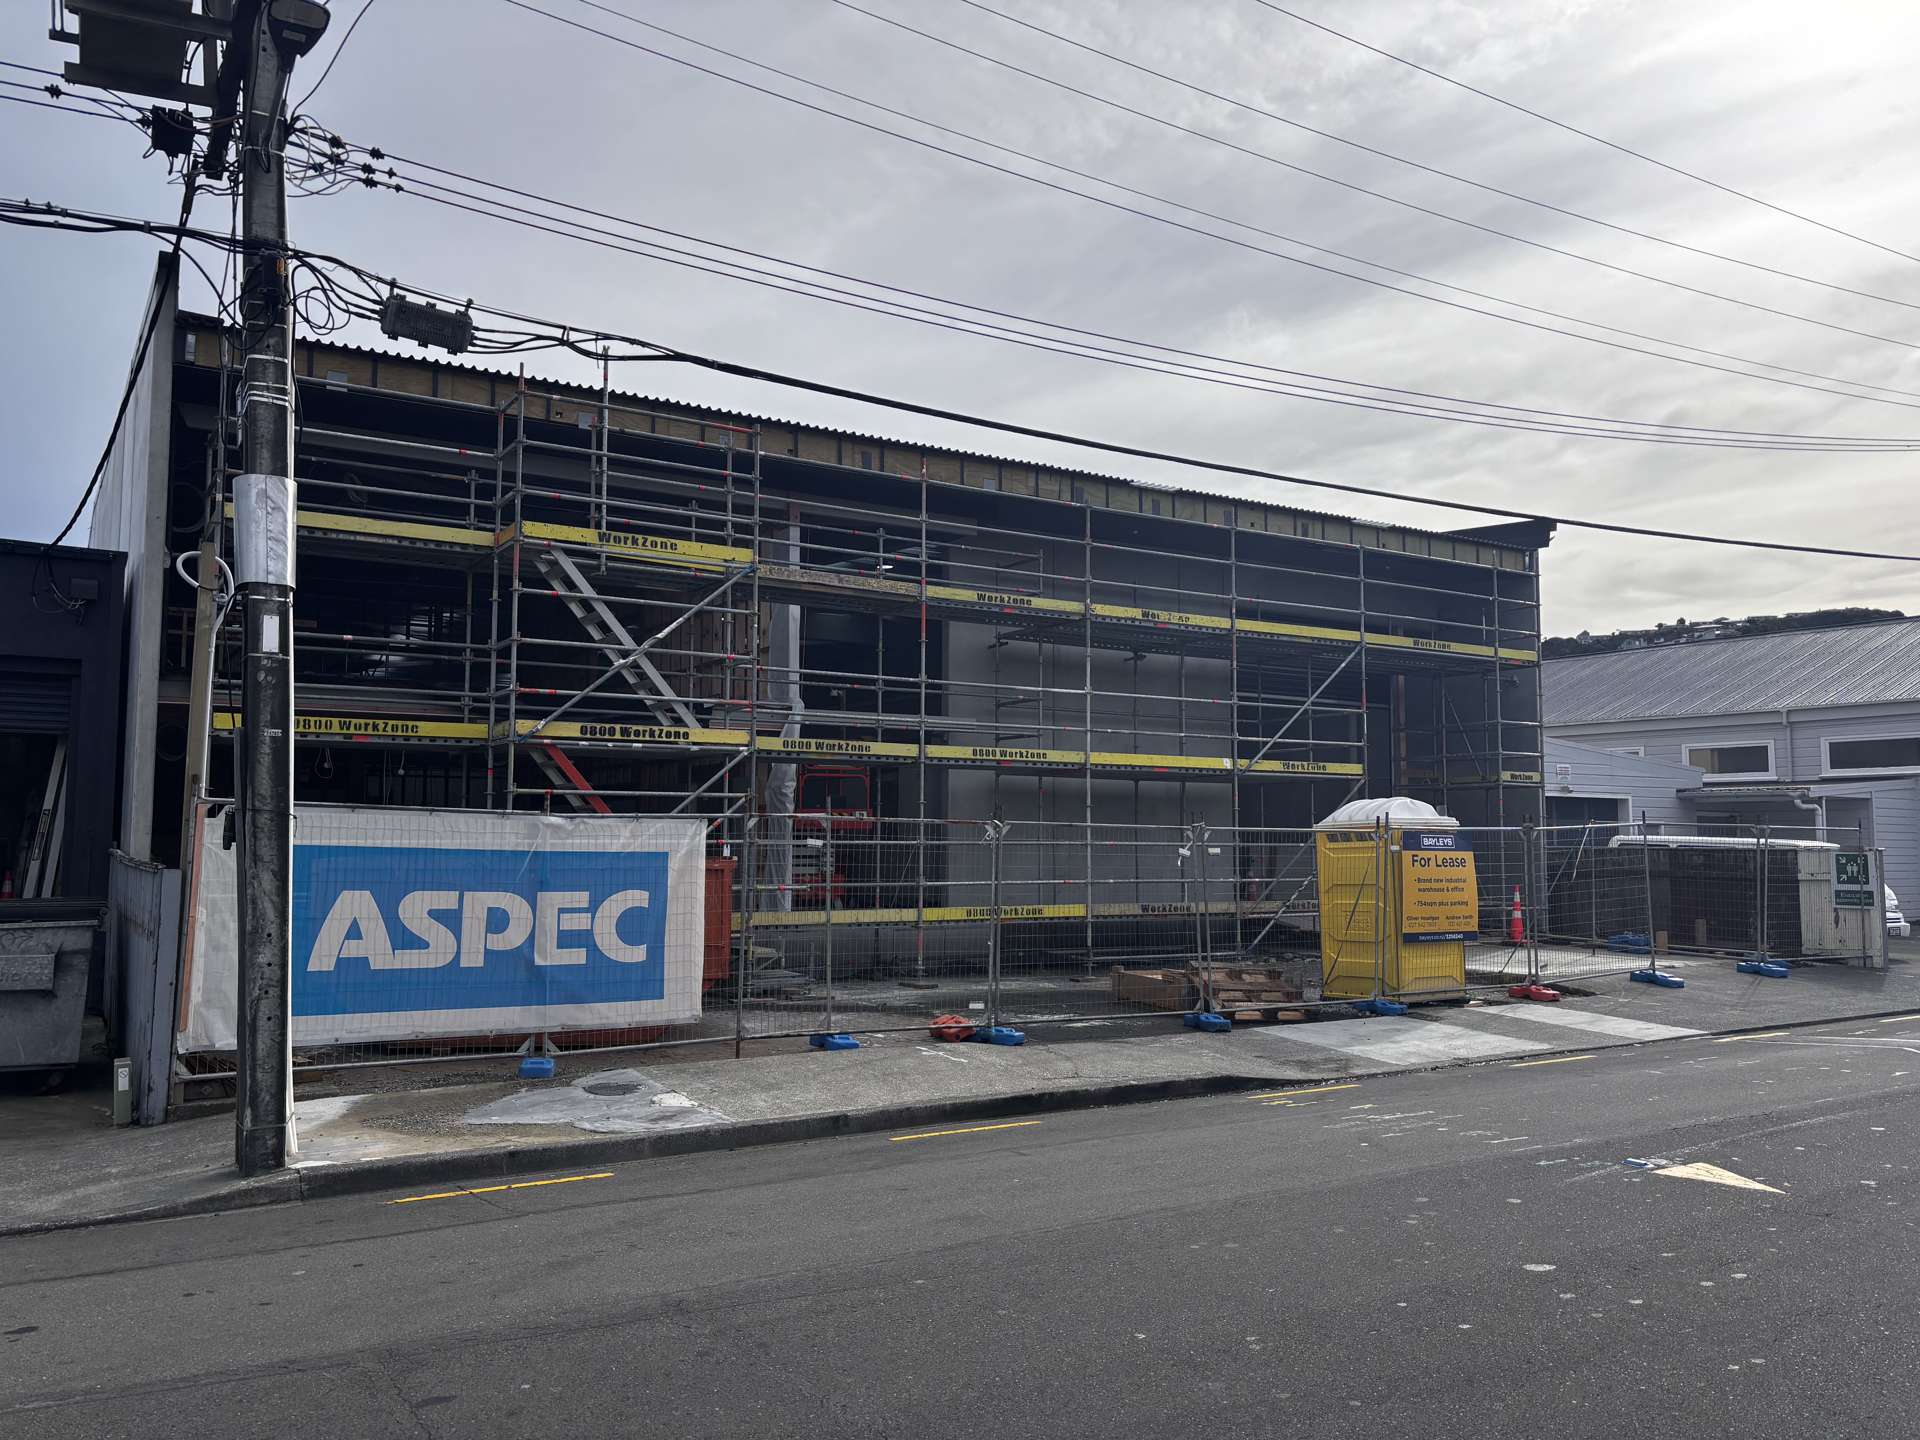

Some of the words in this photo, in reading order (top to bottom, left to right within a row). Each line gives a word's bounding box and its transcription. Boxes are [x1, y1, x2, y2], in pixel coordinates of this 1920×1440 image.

[597, 531, 678, 551] WorkZone
[976, 592, 1032, 606] WorkZone
[338, 720, 419, 734] WorkZone
[580, 725, 616, 737] 0800
[619, 726, 690, 740] WorkZone
[782, 739, 811, 750] 0800
[815, 741, 871, 752] WorkZone
[972, 748, 997, 757] 0800
[1000, 749, 1047, 759] WorkZone
[1423, 837, 1453, 846] BAYLEYS
[1411, 854, 1432, 868] For
[1434, 854, 1467, 868] Lease
[306, 889, 650, 971] ASPEC
